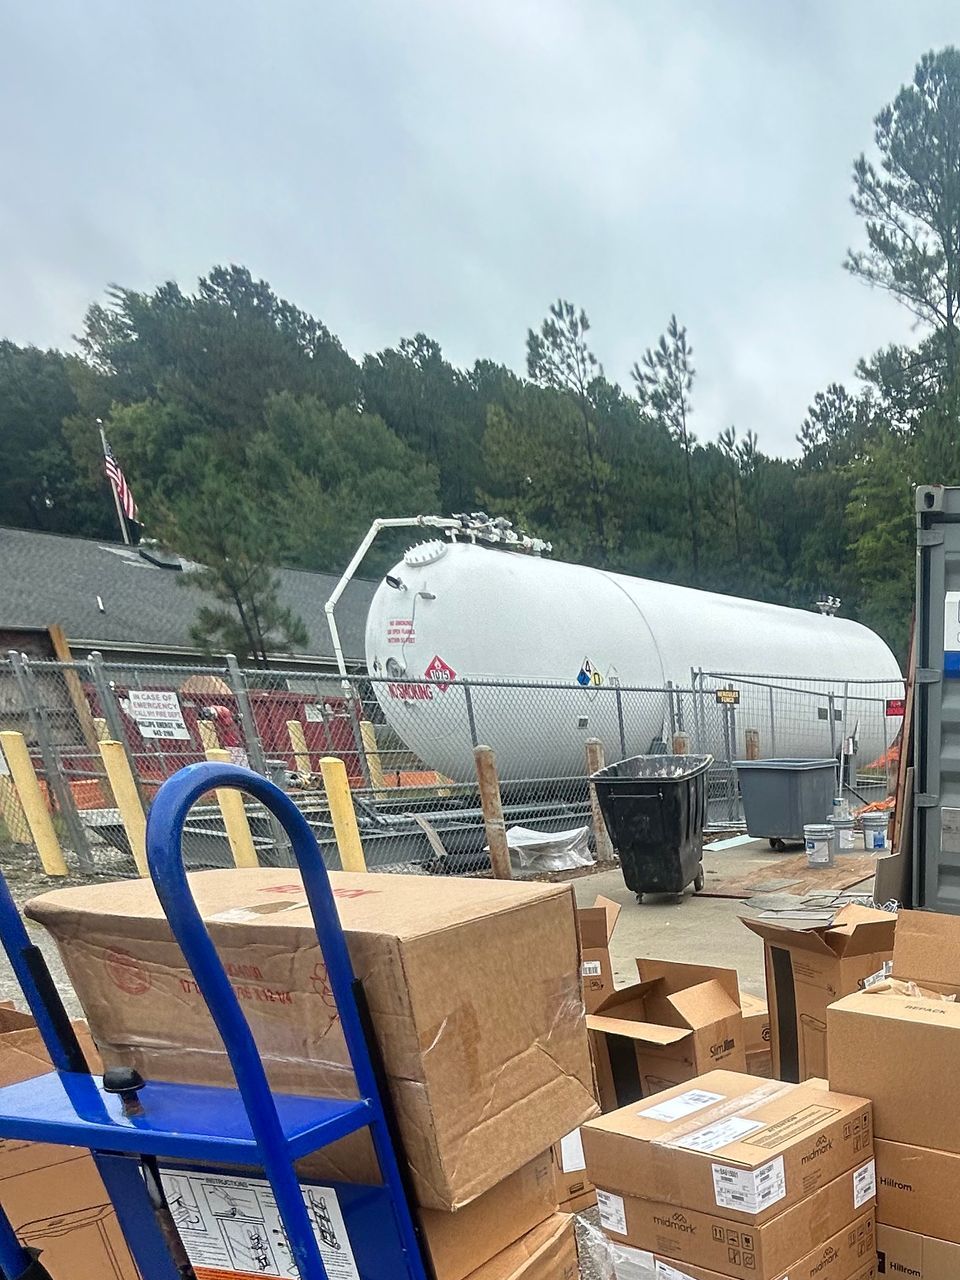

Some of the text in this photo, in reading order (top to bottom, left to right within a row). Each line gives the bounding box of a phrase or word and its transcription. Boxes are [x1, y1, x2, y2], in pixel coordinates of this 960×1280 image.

[432, 670, 449, 680] 1075
[904, 1003, 947, 1015] REPACK
[801, 1140, 833, 1165] midmark
[879, 1175, 913, 1192] Hillrom
[653, 1215, 698, 1235] midmark
[809, 1249, 840, 1278] midmark
[889, 1261, 921, 1278] Hillrom
